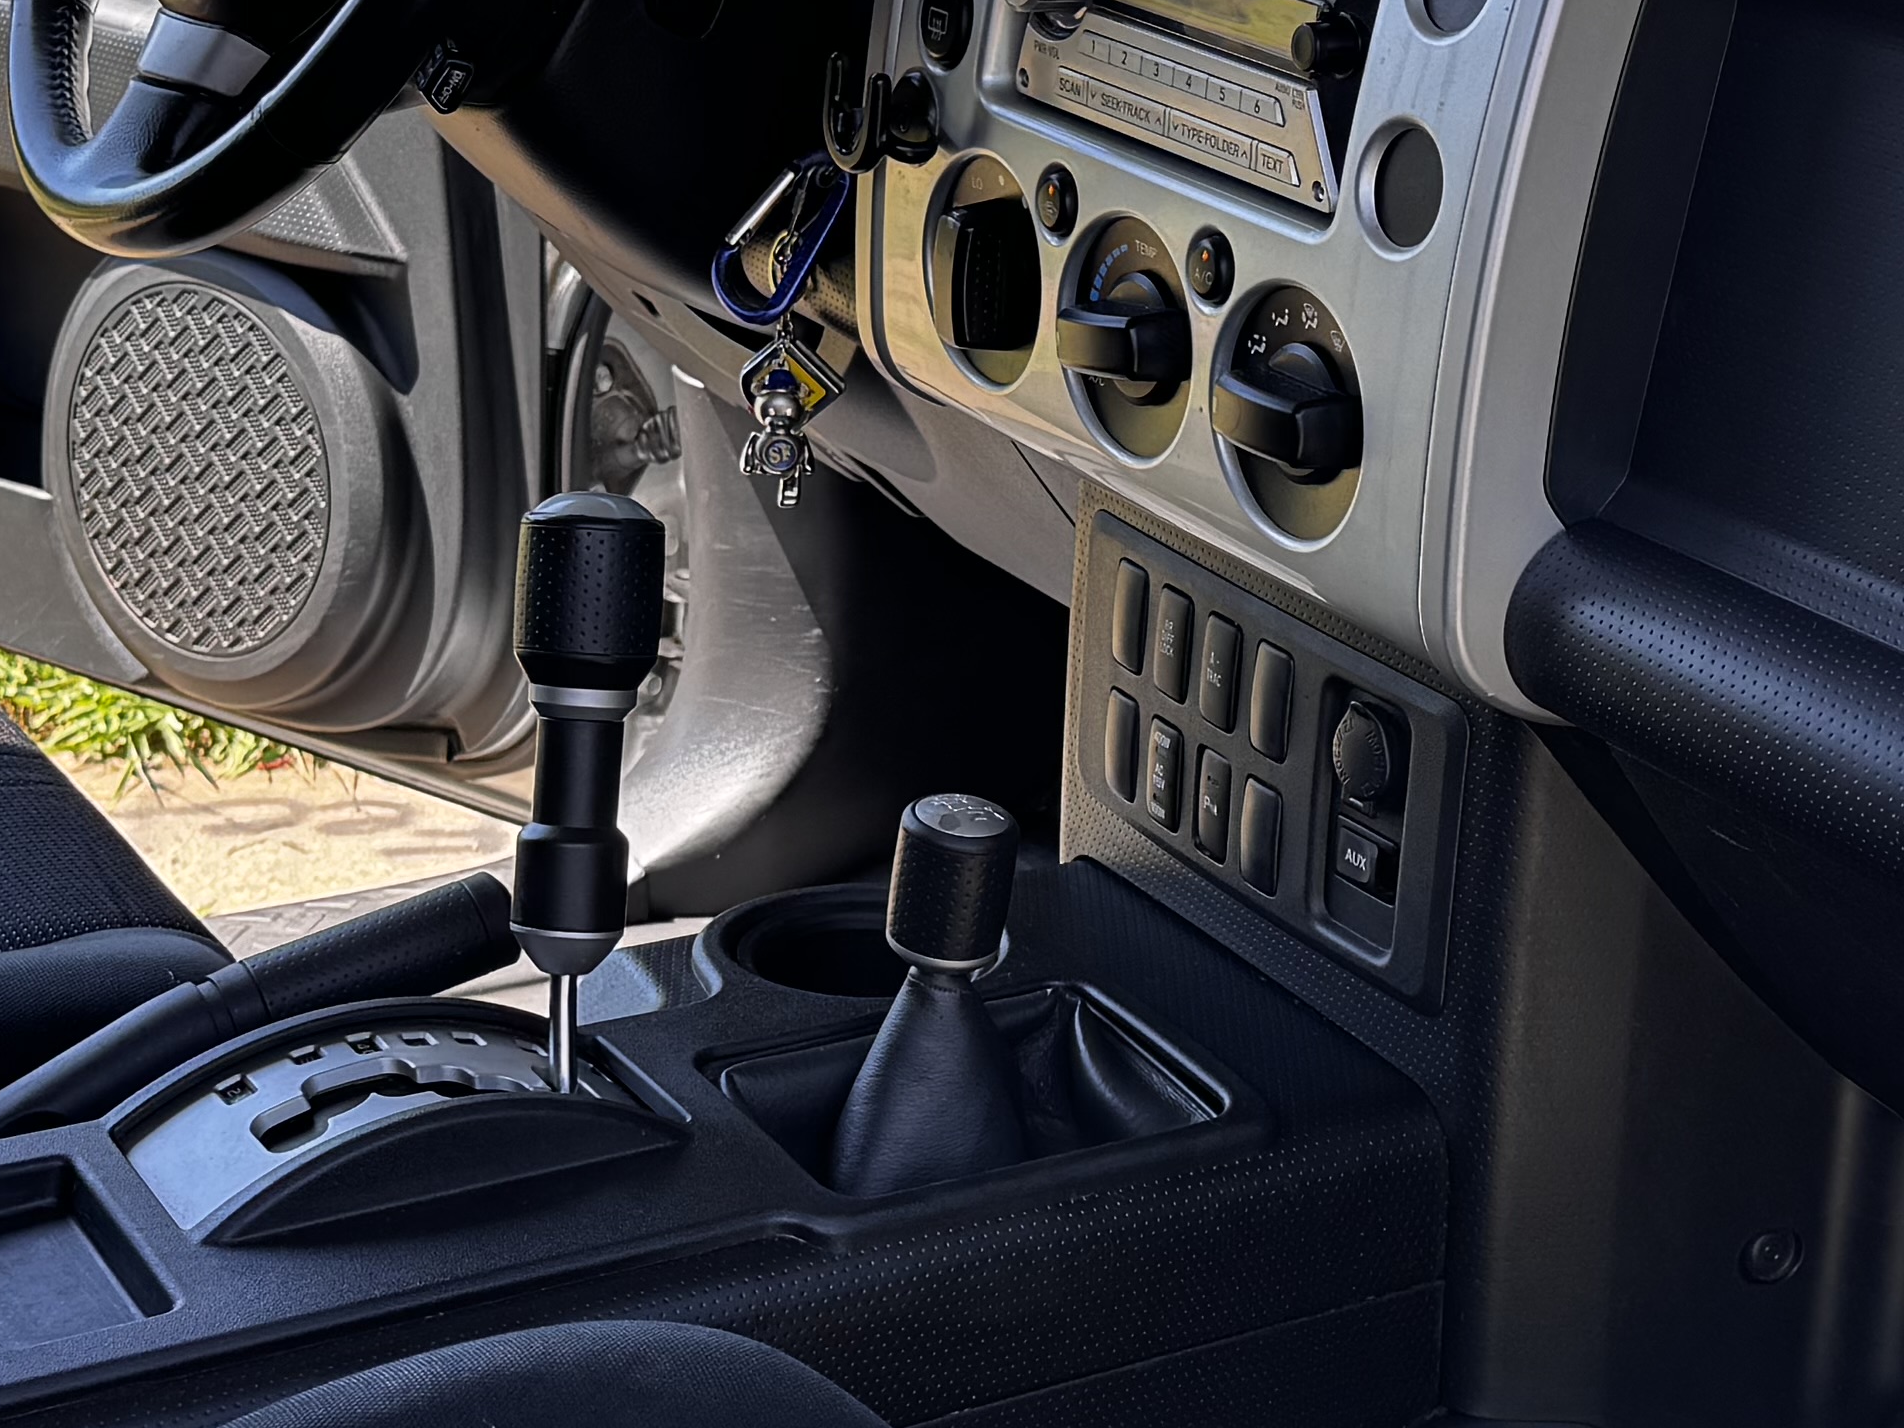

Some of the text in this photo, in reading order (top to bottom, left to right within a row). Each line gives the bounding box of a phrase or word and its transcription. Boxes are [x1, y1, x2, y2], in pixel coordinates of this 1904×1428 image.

[1091, 40, 1096, 54] 1
[1121, 50, 1128, 65] 2
[1153, 62, 1160, 77] 3
[1059, 76, 1082, 98] SCAN
[1185, 74, 1192, 89] 4
[1218, 87, 1226, 102] 5
[1253, 99, 1260, 113] 6
[1261, 153, 1284, 174] TEXT
[971, 178, 983, 190] LO
[1135, 239, 1158, 258] TEMP
[1194, 267, 1214, 285] A/C
[1345, 848, 1367, 871] AUX
